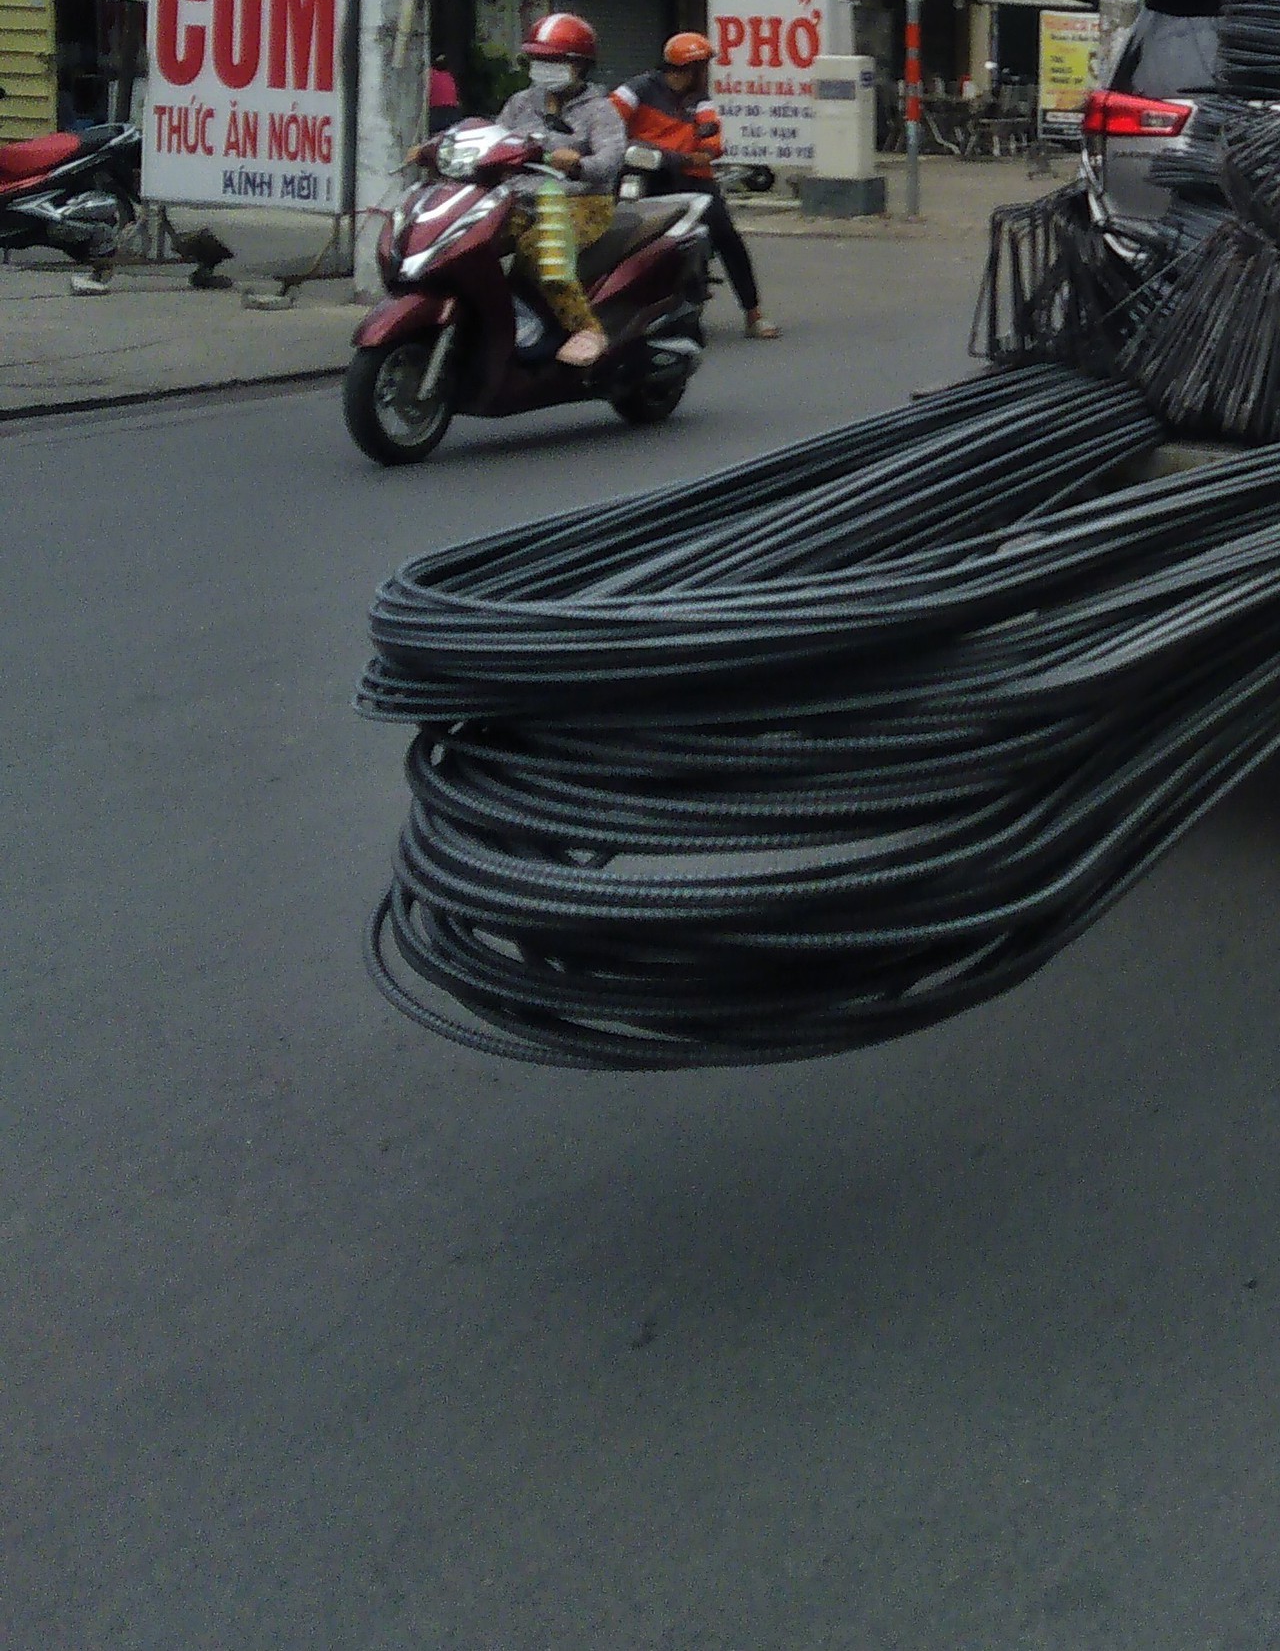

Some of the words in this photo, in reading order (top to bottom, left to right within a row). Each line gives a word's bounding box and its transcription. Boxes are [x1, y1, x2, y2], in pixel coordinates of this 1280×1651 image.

[153, 95, 216, 156] THỨC
[223, 100, 258, 160] ĂN
[268, 101, 332, 164] NÓNG
[222, 164, 273, 198] KÍNH
